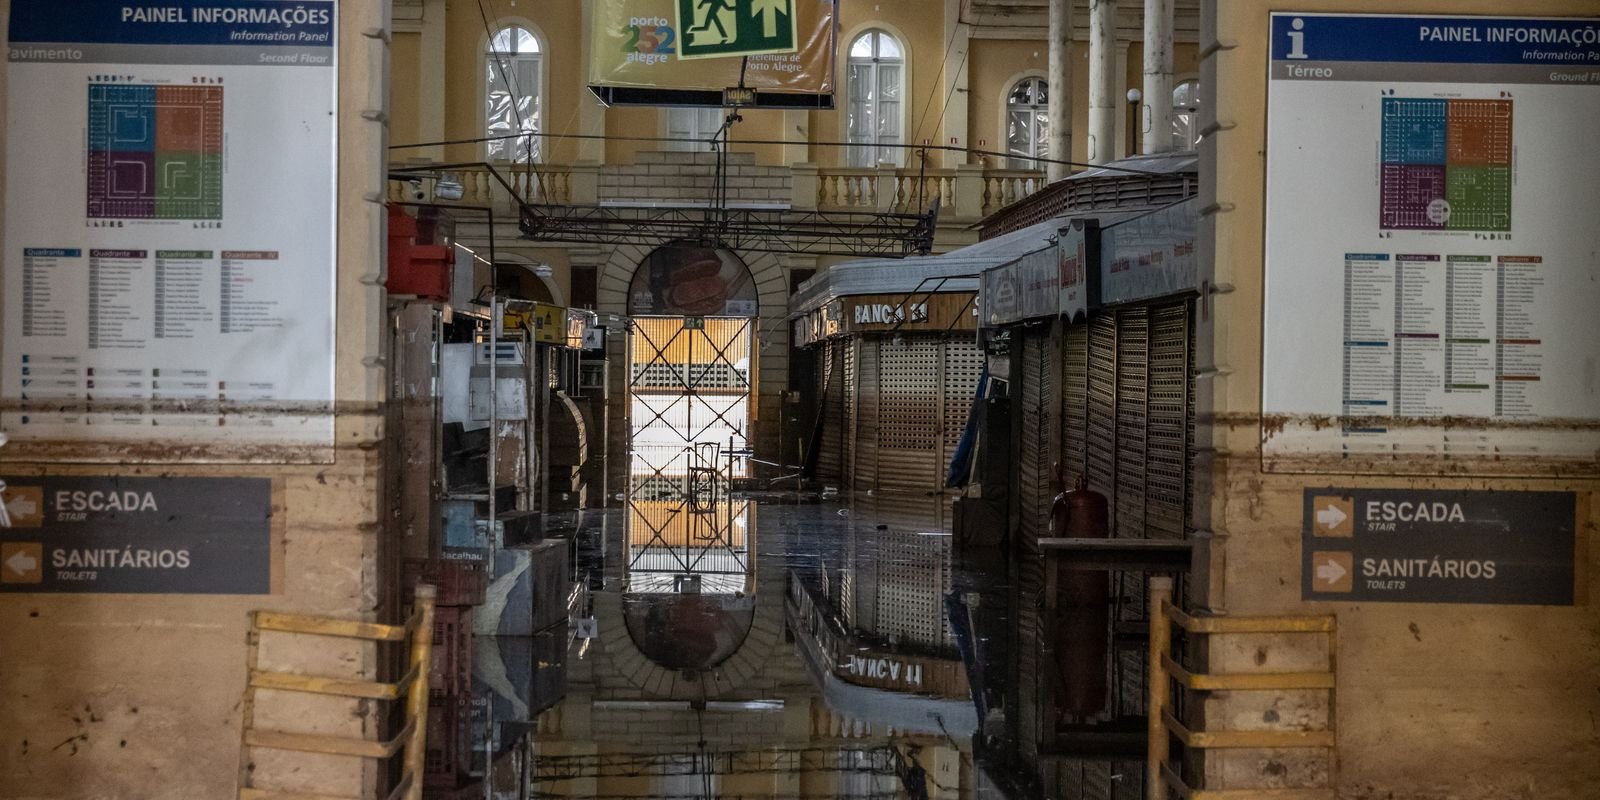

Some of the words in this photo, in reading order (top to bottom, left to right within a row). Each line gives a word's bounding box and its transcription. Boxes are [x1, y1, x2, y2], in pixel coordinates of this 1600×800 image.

[121, 7, 187, 24] PAINEL
[192, 6, 329, 28] INFORMAÇÕES
[630, 16, 668, 27] porto
[230, 30, 296, 42] Information
[299, 31, 329, 42] Panel
[621, 25, 676, 53] 252
[1420, 26, 1482, 42] PAINEL
[259, 53, 297, 64] Second
[300, 53, 328, 64] Floor
[627, 52, 668, 65] alegre
[790, 54, 801, 62] de
[1522, 49, 1585, 60] Information
[773, 62, 802, 73] Alegre
[1286, 64, 1333, 78] Térreo
[1549, 72, 1588, 81] Ground
[1590, 73, 1600, 81] Fl
[855, 304, 905, 324] BANCA
[910, 303, 928, 322] 11
[56, 491, 158, 512] ESCADA
[57, 512, 87, 521] STAIR
[1366, 501, 1466, 524] ESCADA
[1368, 522, 1398, 532] STAIR
[52, 545, 190, 569] SANITÁRIOS
[1361, 555, 1496, 579] SANITÁRIOS
[57, 570, 98, 581] TOILETS
[1366, 580, 1407, 590] TOILETS
